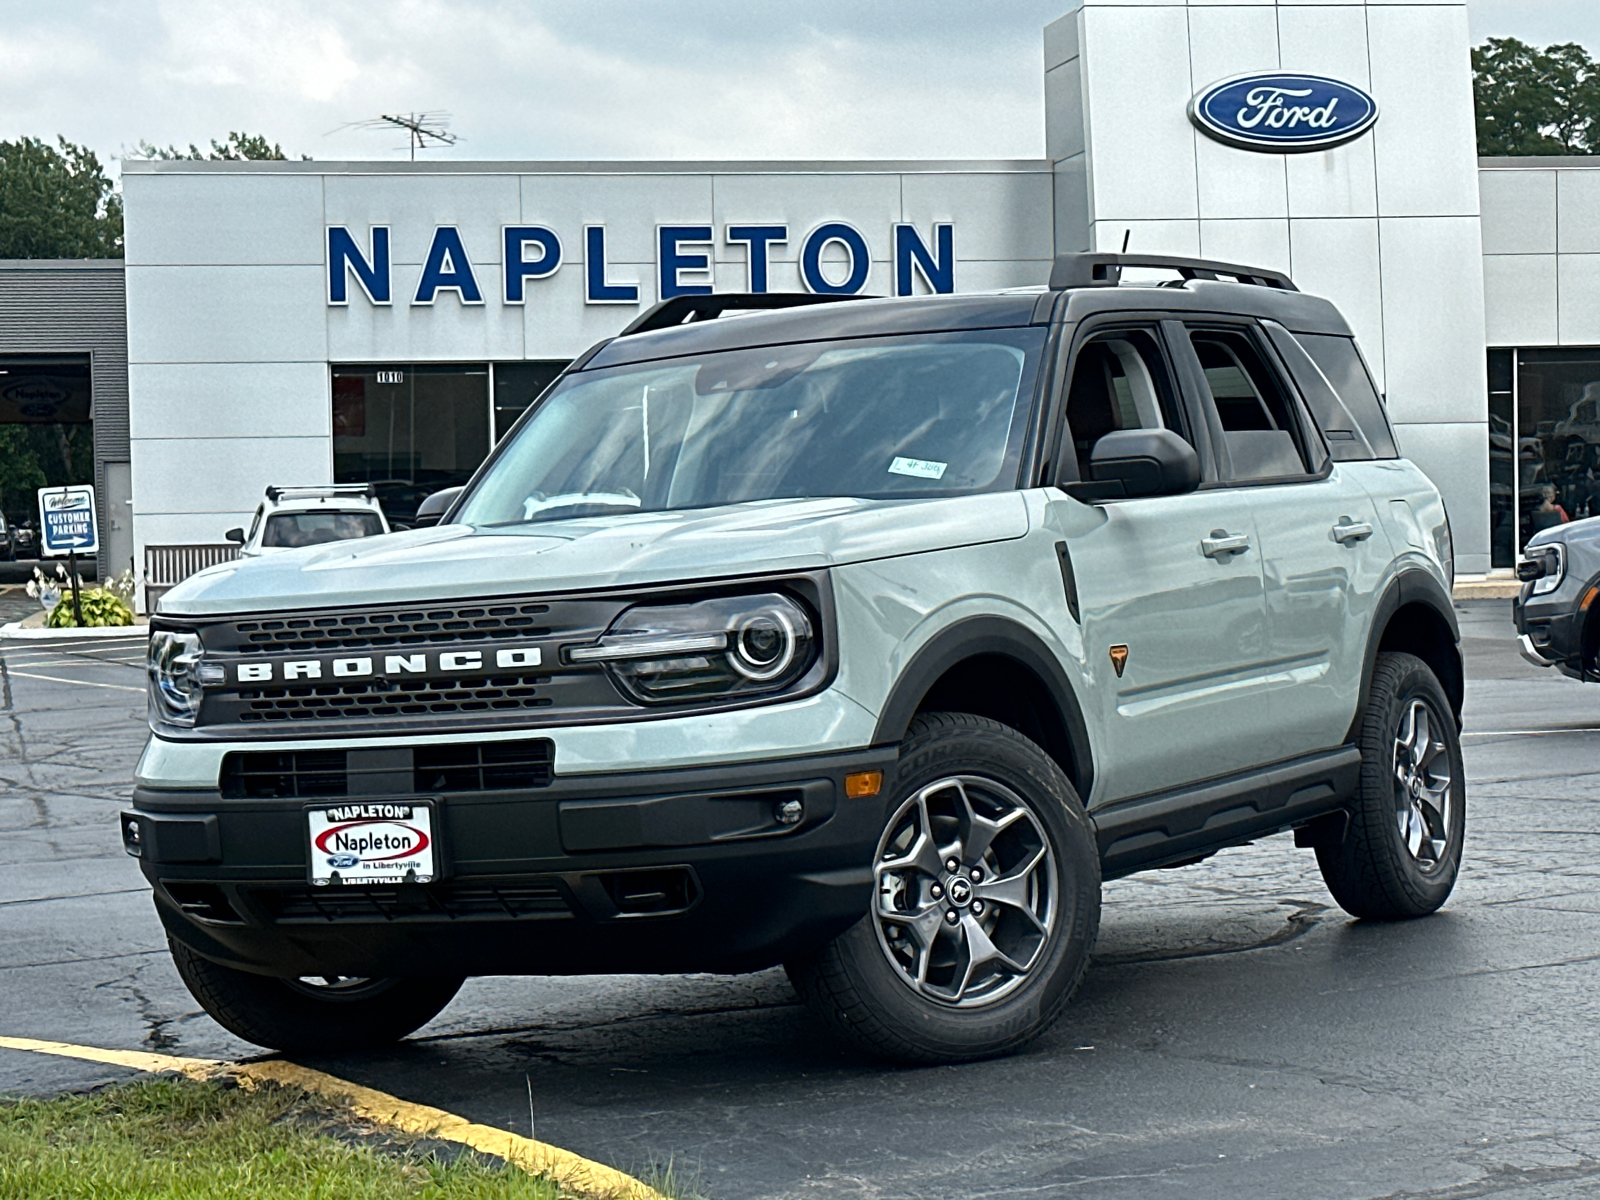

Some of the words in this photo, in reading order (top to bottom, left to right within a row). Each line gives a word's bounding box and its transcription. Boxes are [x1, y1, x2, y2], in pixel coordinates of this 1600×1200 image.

[1236, 86, 1339, 128] Ford
[326, 222, 956, 307] NAPLETON
[378, 371, 403, 383] 1010
[48, 512, 90, 525] CUSTOMER
[52, 523, 88, 535] PARKING
[237, 647, 542, 682] BRONCO
[333, 805, 405, 820] NAPLETON
[335, 832, 411, 855] Napleton
[333, 856, 354, 866] Ford
[373, 861, 421, 870] Libertyville
